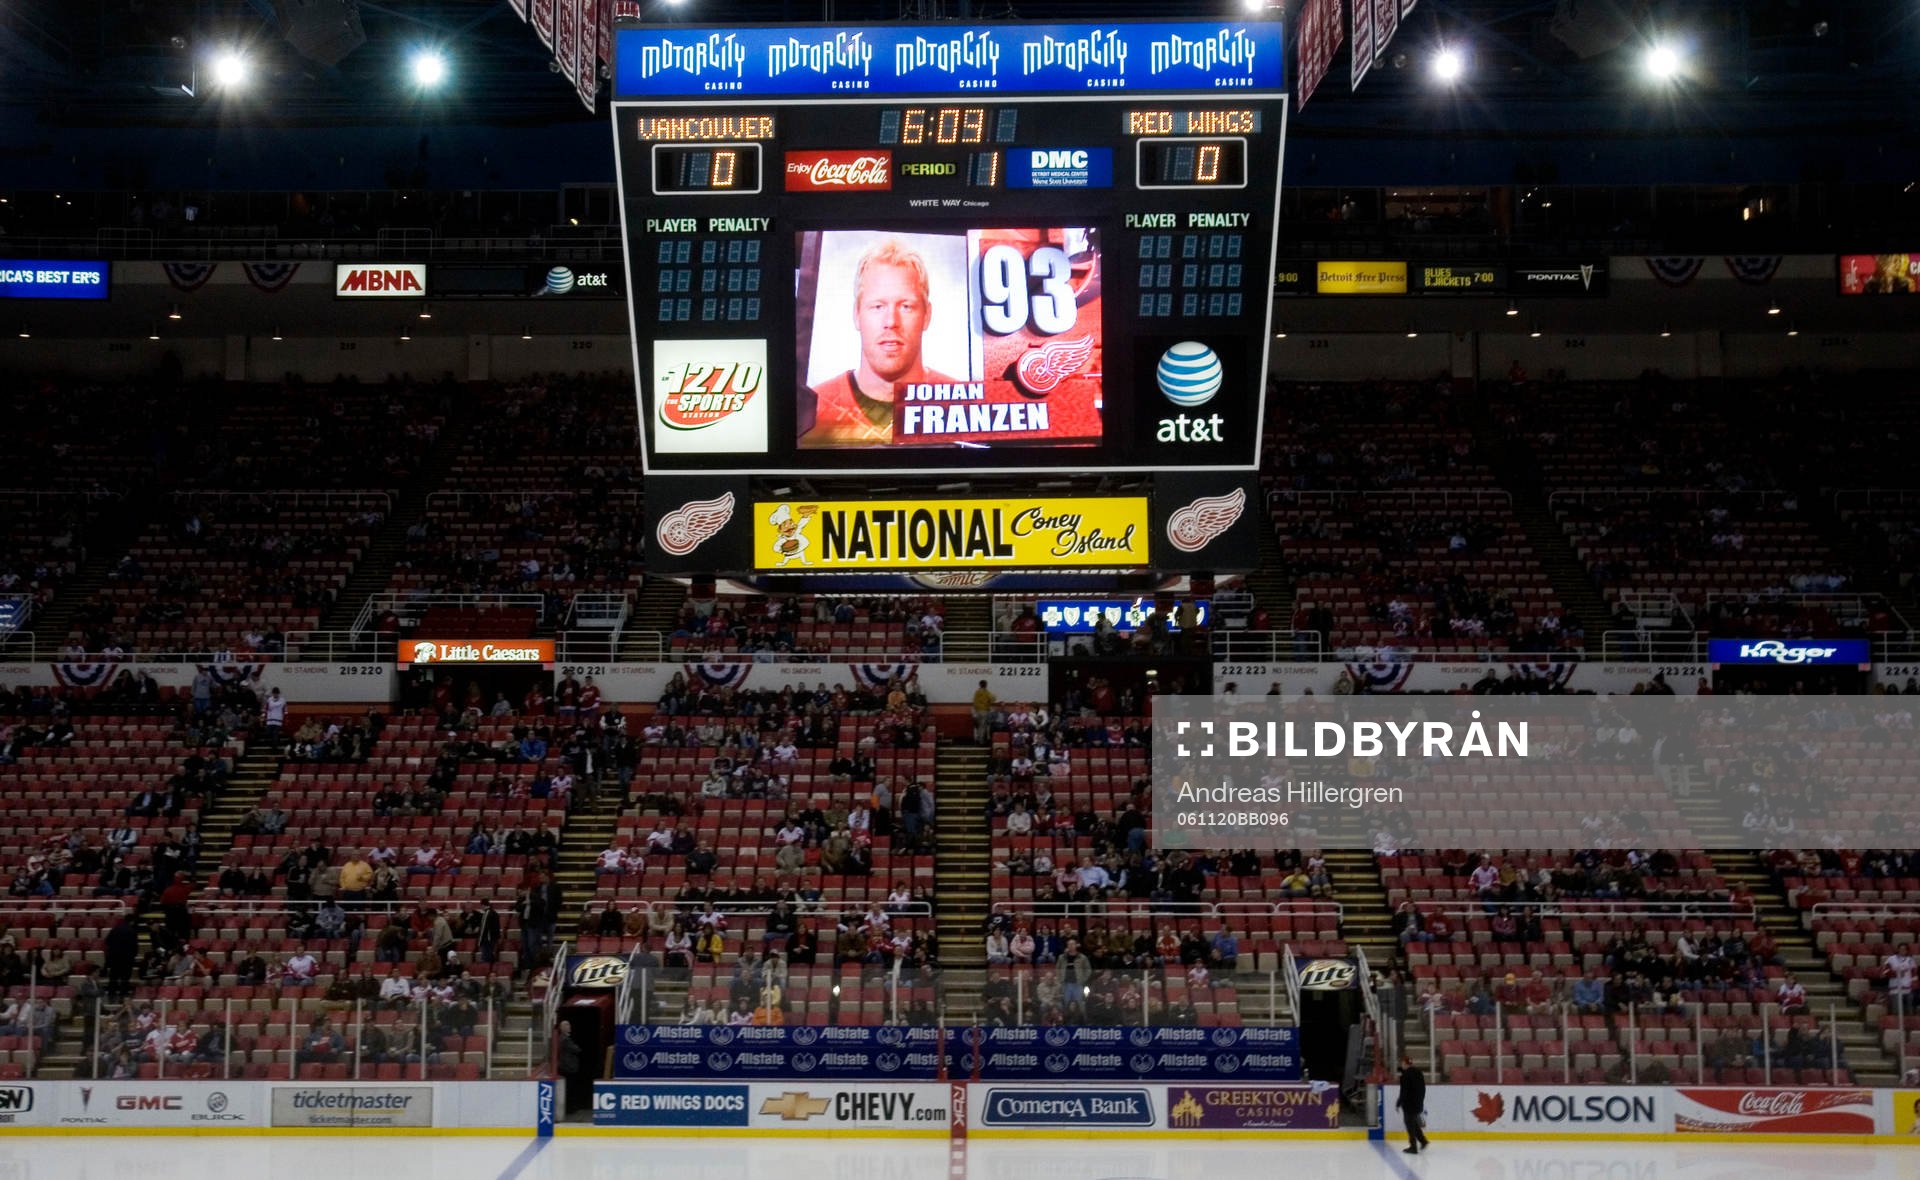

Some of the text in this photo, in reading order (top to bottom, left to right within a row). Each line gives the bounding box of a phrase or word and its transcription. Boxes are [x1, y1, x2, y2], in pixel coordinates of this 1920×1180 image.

[705, 82, 742, 90] CASINO
[832, 81, 870, 89] CASINO
[959, 80, 997, 88] CASINO
[1087, 79, 1125, 87] CASINO
[1215, 78, 1253, 86] CASINO
[639, 117, 773, 139] VANCOUVER
[903, 108, 984, 144] 6:09
[1129, 110, 1254, 134] RED WINGS
[1032, 150, 1088, 169] DMC
[1197, 146, 1220, 181] 0
[712, 152, 736, 186] 0
[787, 162, 812, 175] Enjoy
[902, 163, 957, 175] PERIOD
[646, 217, 770, 233] PLAYER PENALTY
[1125, 213, 1250, 228] PLAYER PENALTY
[36, 271, 70, 284] BEST
[72, 271, 100, 284] ER'S
[577, 272, 607, 287] at&t
[1319, 272, 1405, 283] Detroit Free Press
[1424, 268, 1451, 278] BLUES
[1474, 272, 1494, 283] 7:00
[340, 270, 423, 291] MBNA
[981, 244, 1078, 335] 93
[668, 361, 762, 395] 1270
[904, 383, 984, 401] JOHAN
[678, 393, 745, 412] SPORTS
[903, 402, 1049, 435] FRANZEN
[1156, 413, 1224, 442] at&t
[821, 506, 1082, 561] NATIONAL Coney
[1051, 524, 1135, 557] Island
[440, 644, 540, 662] Little Caesars
[1740, 640, 1838, 665] Kroger
[340, 666, 383, 675] 219 220
[587, 666, 605, 675] 221
[1000, 667, 1041, 676] 221 222
[1222, 666, 1266, 675] 222 223
[1659, 666, 1704, 676] 223 224
[577, 963, 627, 984] Lite
[1302, 967, 1353, 987] Lite
[653, 1026, 701, 1038] Allstate
[736, 1027, 785, 1039] Allstate
[819, 1027, 869, 1039] Allstate
[989, 1028, 1038, 1040] Allstate
[1072, 1028, 1122, 1040] Allstate
[1154, 1028, 1205, 1040] Allstate
[1240, 1028, 1292, 1040] Allstate
[650, 1052, 700, 1064] Allstate
[735, 1053, 784, 1065] Allstate
[819, 1053, 869, 1065] Allstate
[903, 1053, 952, 1065] Allstae
[988, 1054, 1038, 1066] Allstate
[1071, 1054, 1122, 1066] Allstate
[1157, 1054, 1207, 1066] Allstate
[1242, 1054, 1292, 1067] Allstate
[116, 1095, 183, 1110] GMC
[293, 1091, 412, 1109] ticketmaster
[621, 1095, 650, 1110] RED
[653, 1095, 701, 1110] WINGS
[704, 1095, 744, 1110] DOCS
[1206, 1091, 1322, 1106] GREEKTOWN
[835, 1092, 946, 1121] CHEVY.com
[1090, 1097, 1139, 1115] Bank
[1236, 1107, 1294, 1117] CASINO
[1512, 1095, 1655, 1122] MOLSON
